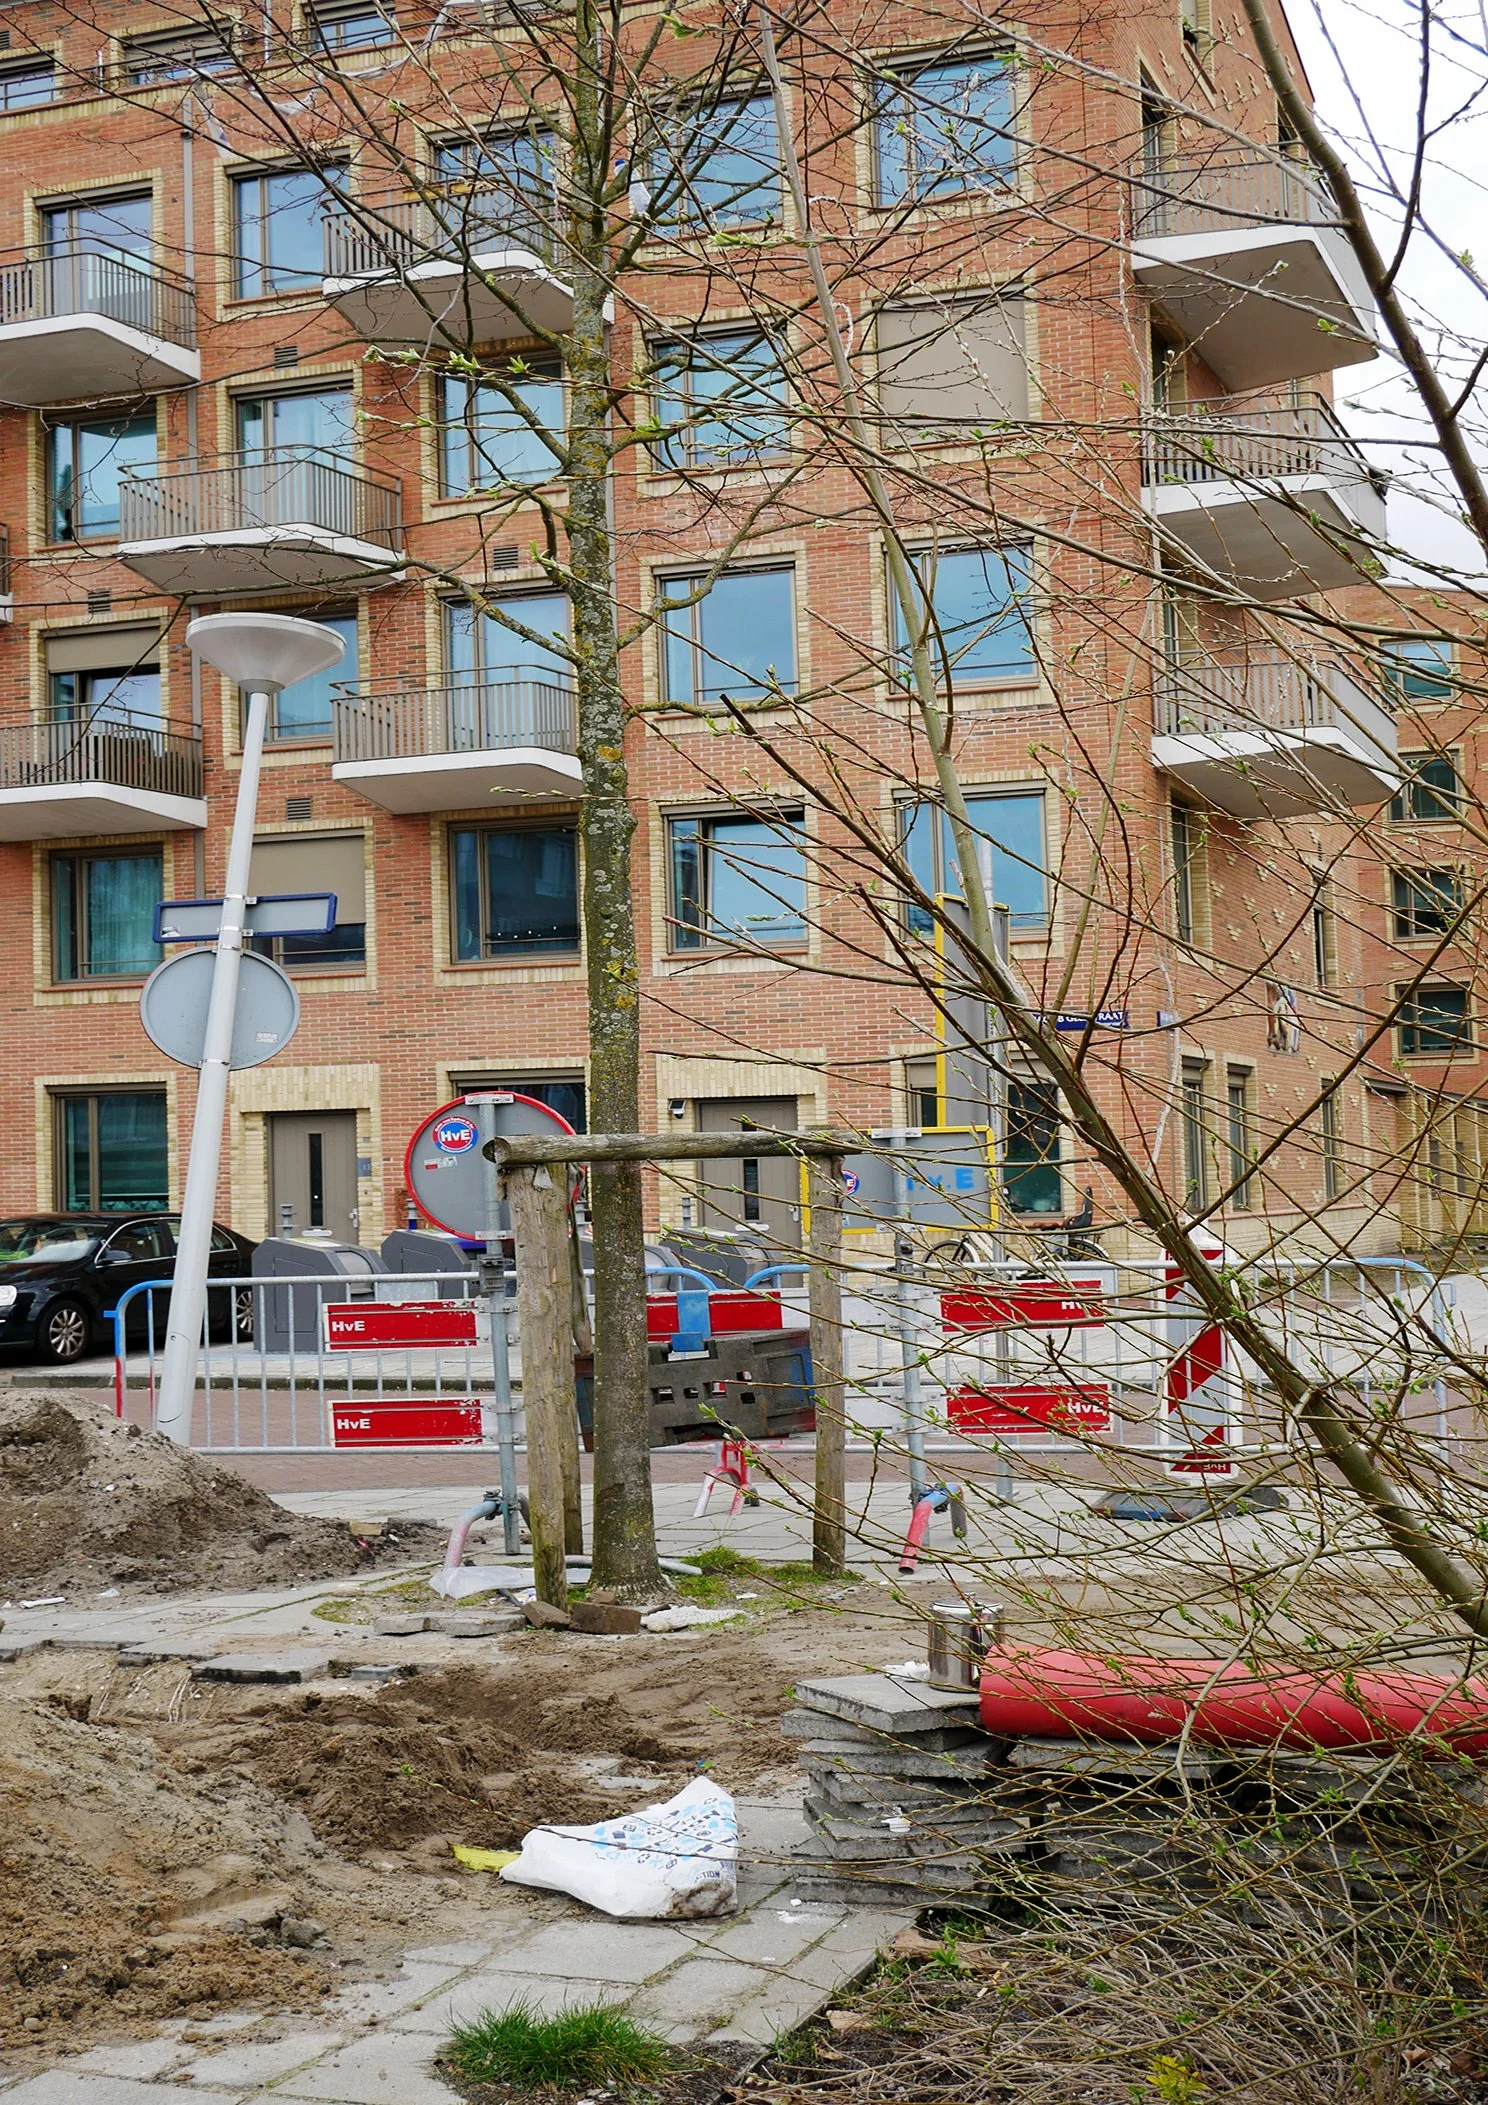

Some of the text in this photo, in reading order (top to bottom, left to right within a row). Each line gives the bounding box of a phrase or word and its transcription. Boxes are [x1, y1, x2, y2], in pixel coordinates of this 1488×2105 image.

[440, 1129, 471, 1142] HvE
[331, 1320, 365, 1332] HvE
[336, 1418, 371, 1430] HvE
